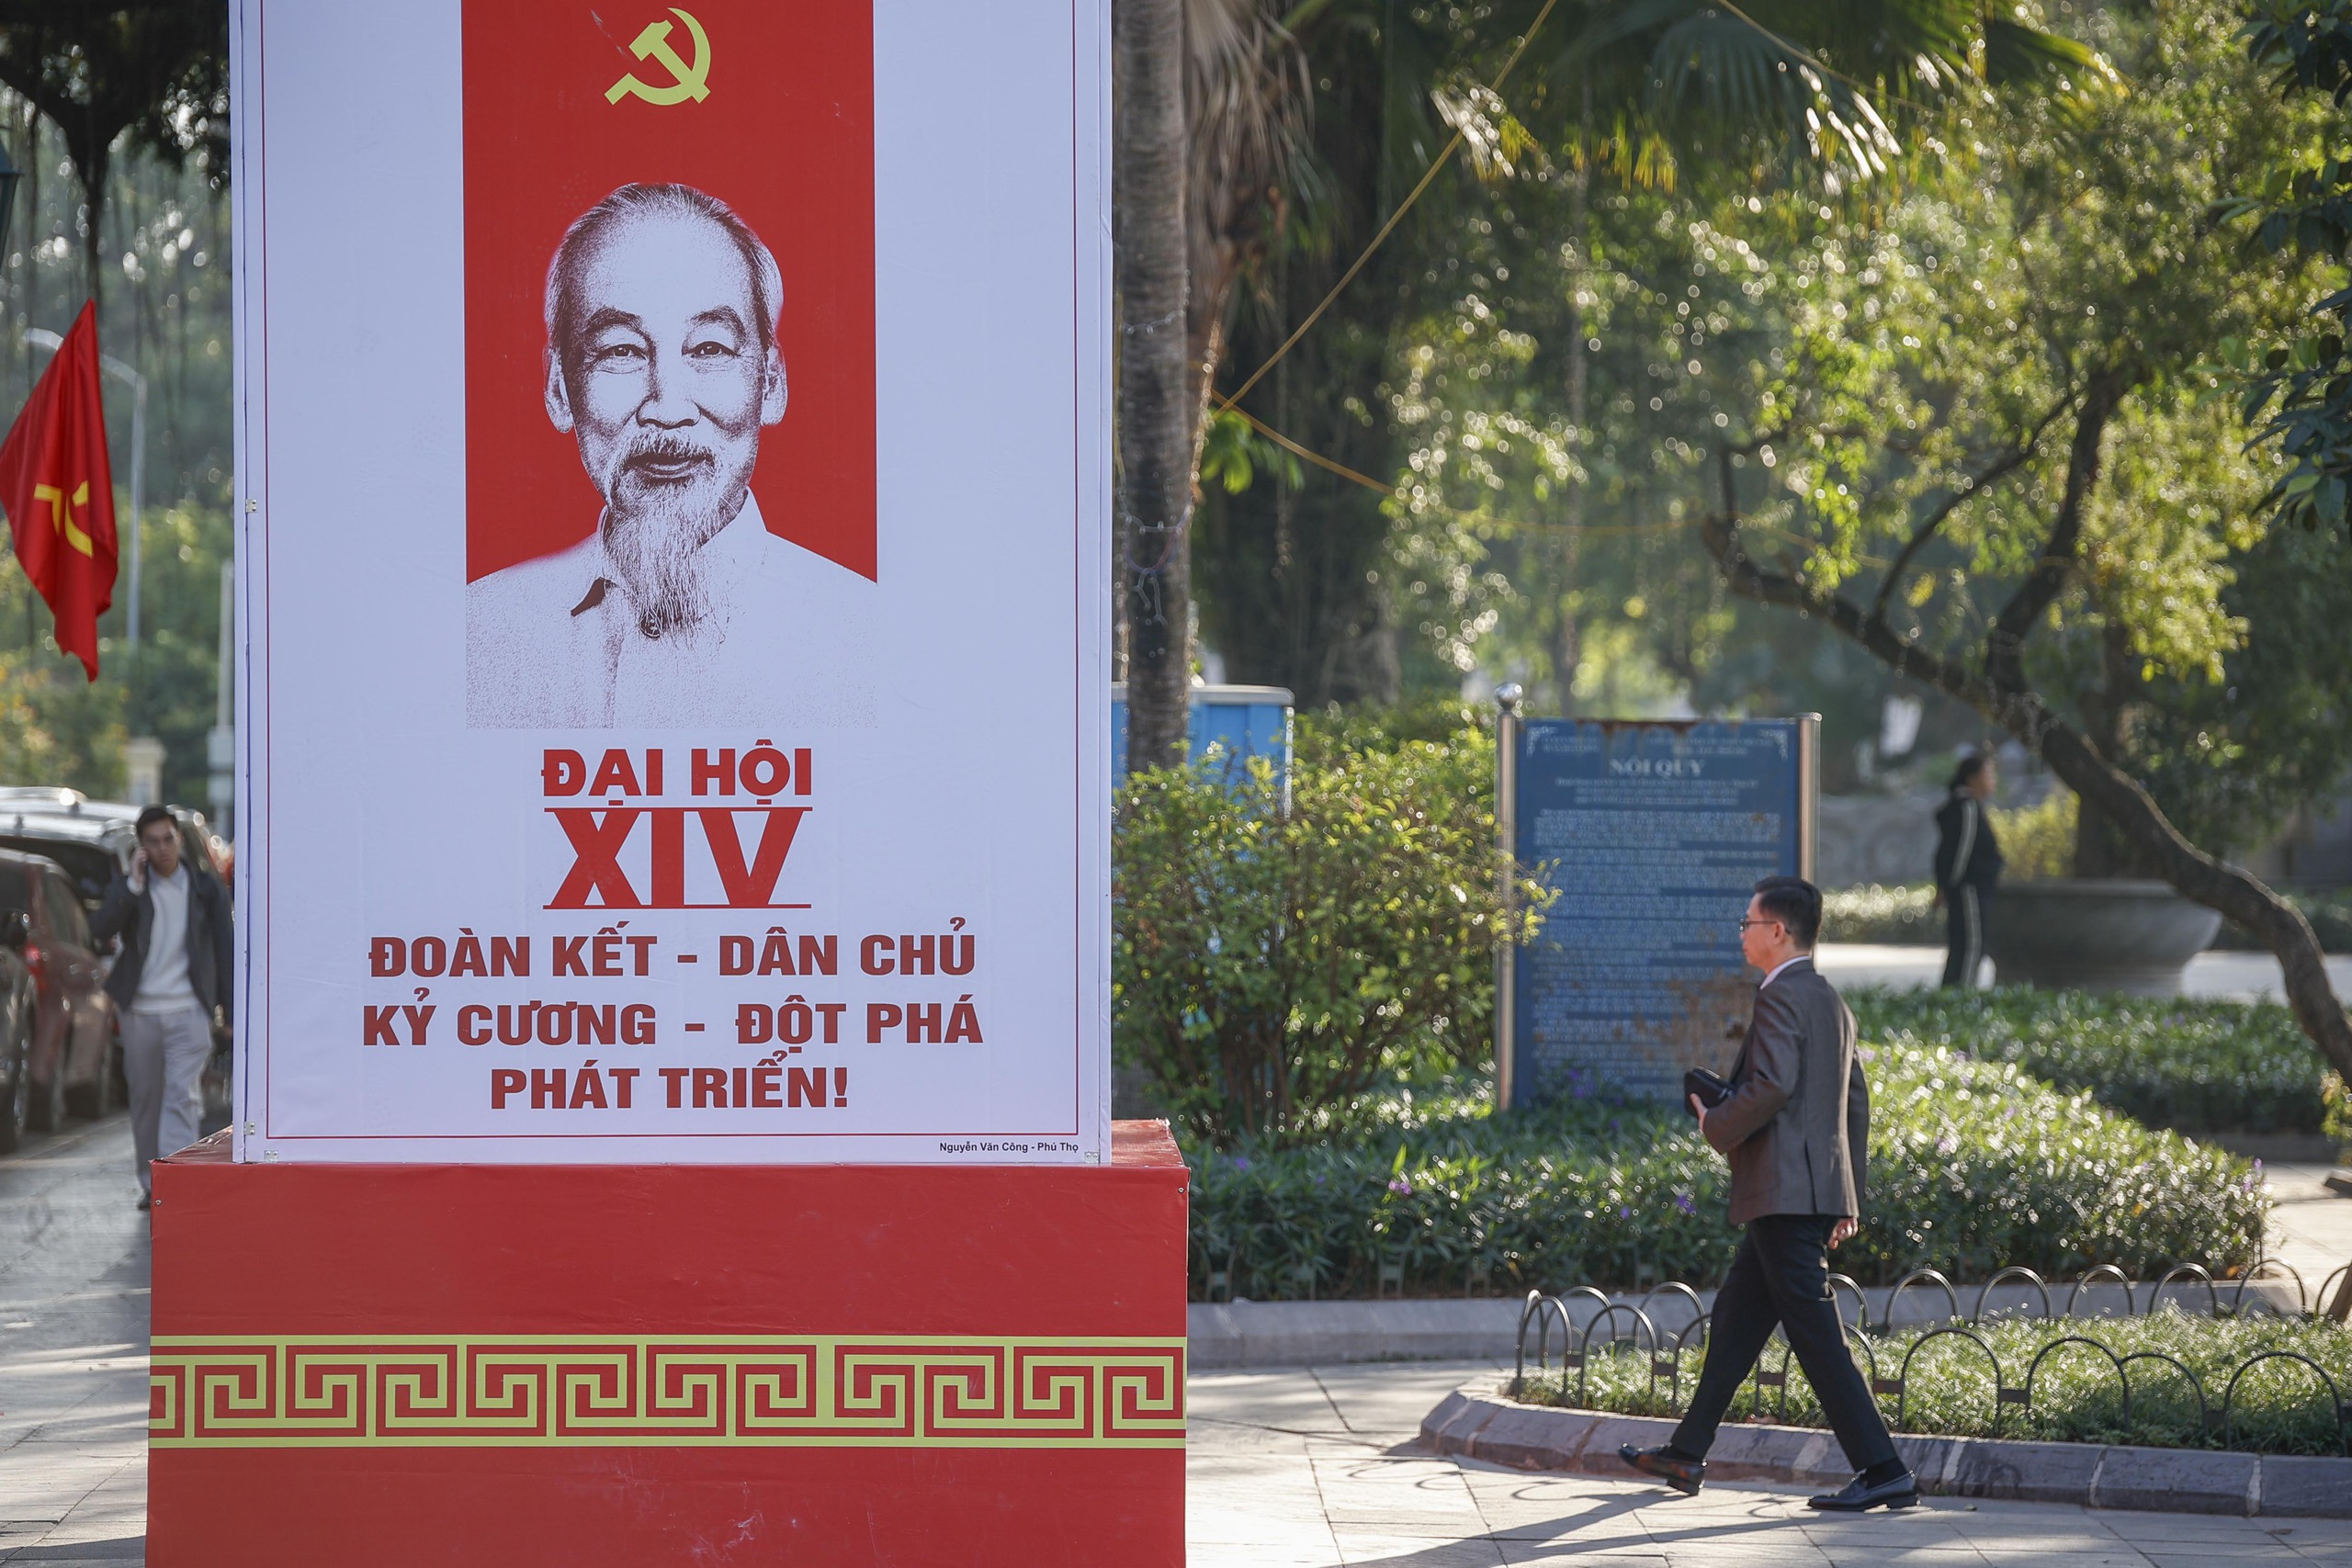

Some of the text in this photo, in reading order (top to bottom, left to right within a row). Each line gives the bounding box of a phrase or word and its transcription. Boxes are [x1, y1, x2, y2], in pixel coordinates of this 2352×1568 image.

[540, 739, 813, 807] ĐẠI HỘI
[543, 806, 813, 909] XIV
[368, 917, 976, 977] ĐOÀN KẾT - DÂN CHỦ
[364, 987, 983, 1054] KỶ CƯƠNG - ĐỘT PHÁ
[492, 1049, 848, 1110] PHÁT TRIỂN!
[939, 1140, 978, 1154] Nguyễn
[979, 1142, 1000, 1152] Văn
[1001, 1142, 1029, 1154] Công
[1037, 1142, 1057, 1152] Phú
[1059, 1142, 1079, 1154] Thọ
